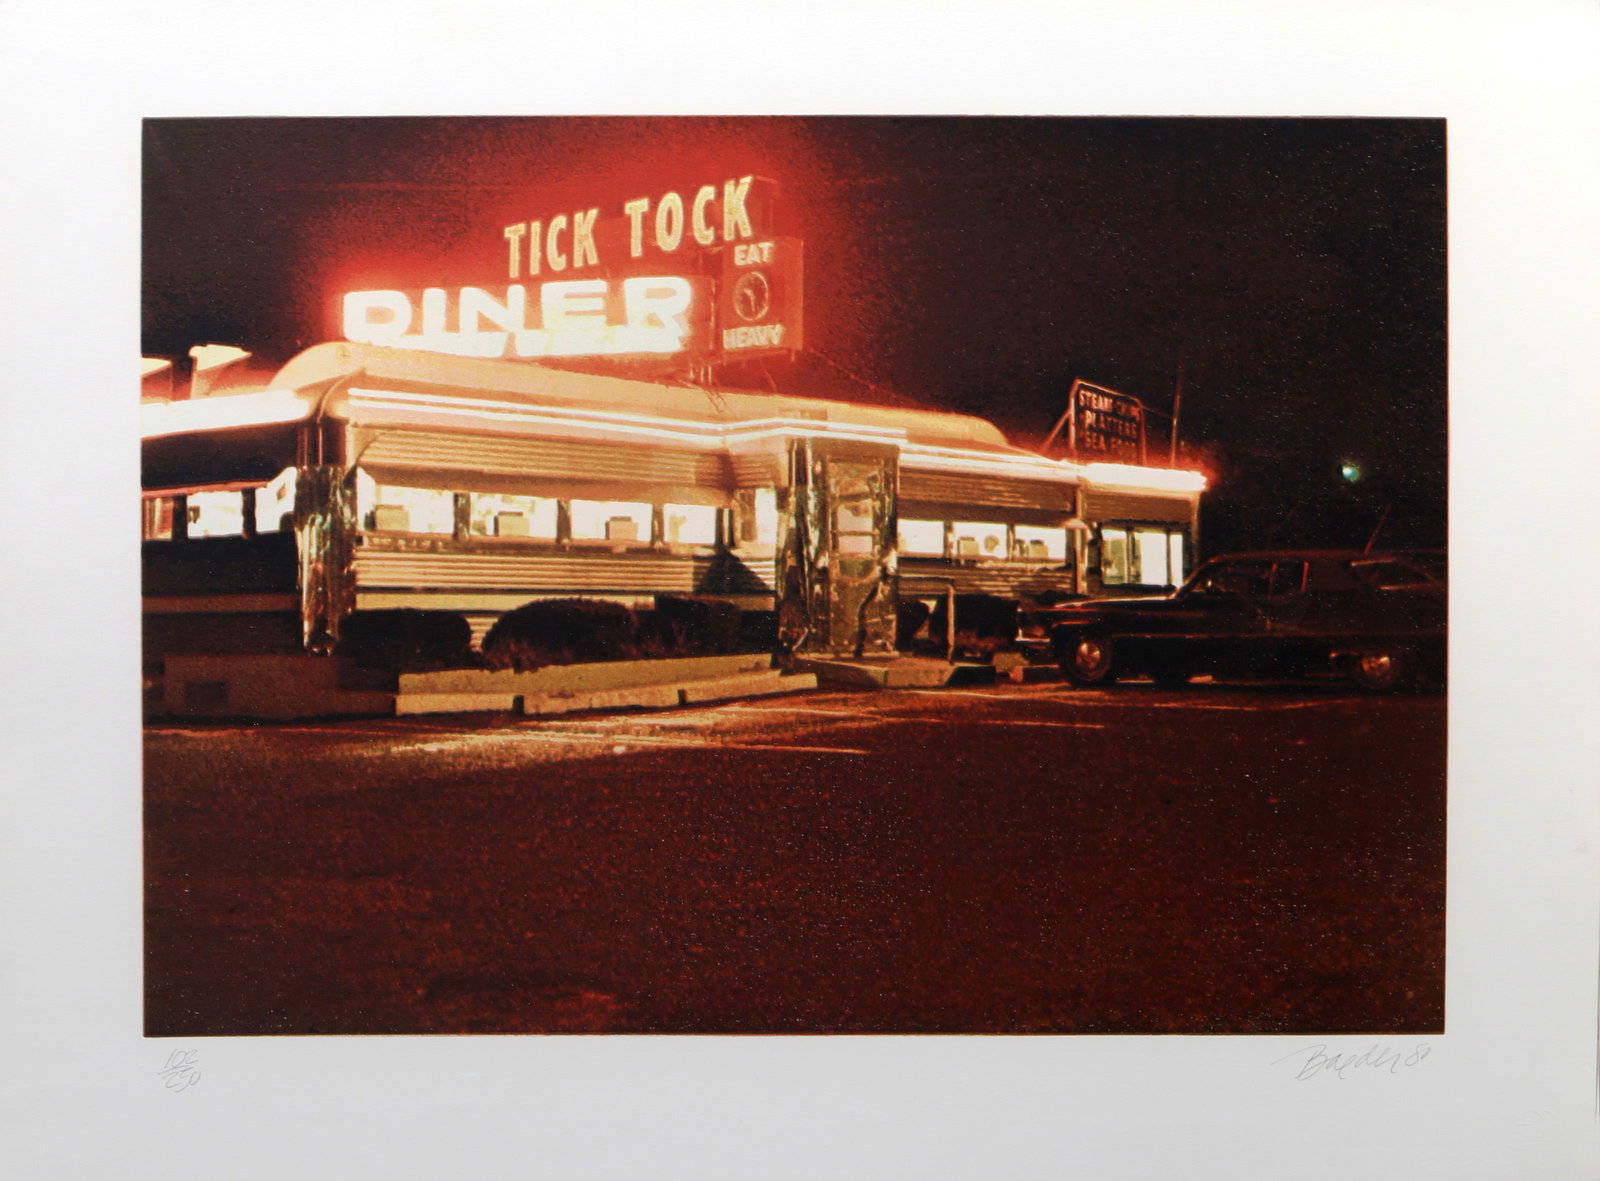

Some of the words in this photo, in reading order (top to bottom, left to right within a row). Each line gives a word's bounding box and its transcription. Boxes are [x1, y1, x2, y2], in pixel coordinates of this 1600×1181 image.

[504, 208, 598, 278] TICK
[625, 175, 754, 258] TOCK
[734, 241, 775, 266] EAT
[343, 276, 693, 356] DINER
[722, 323, 784, 350] HEAVY
